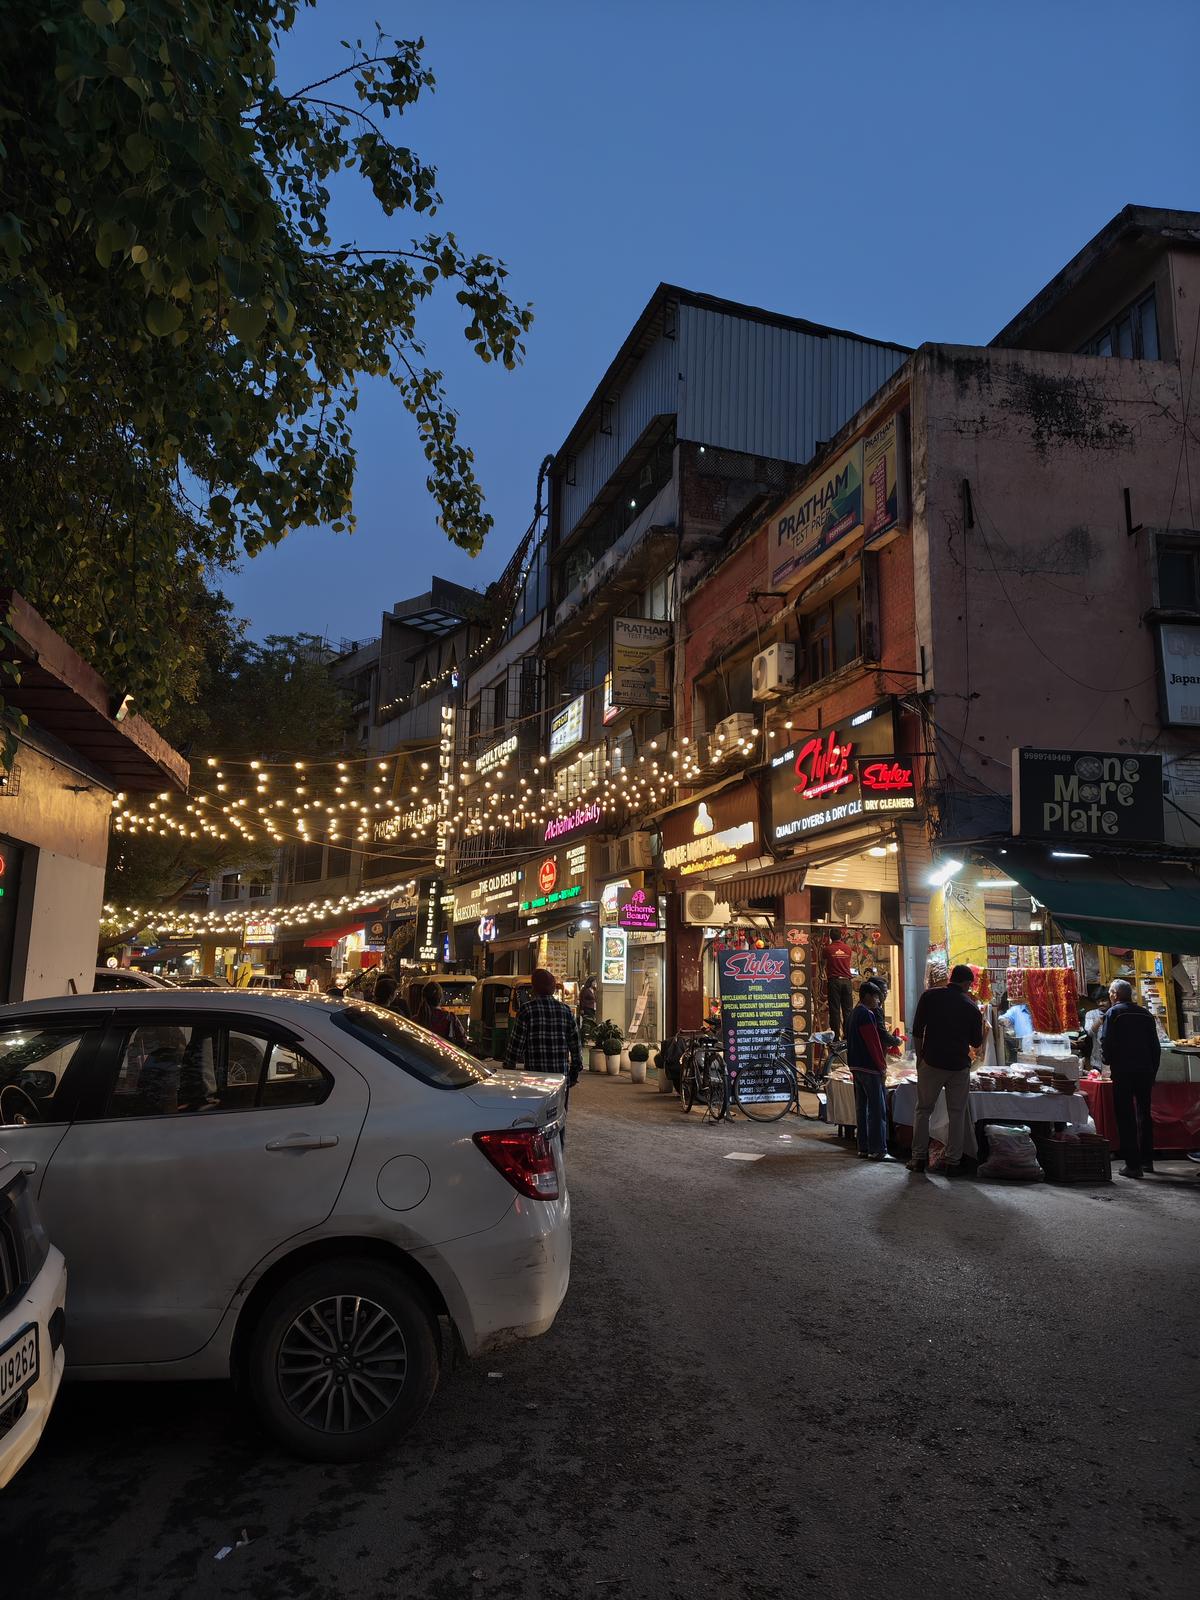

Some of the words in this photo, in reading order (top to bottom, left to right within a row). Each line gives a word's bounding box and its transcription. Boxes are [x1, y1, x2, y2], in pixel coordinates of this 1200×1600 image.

[865, 419, 895, 451] PRATHAM
[778, 465, 848, 546] PRATHAM
[792, 523, 809, 548] TEST
[616, 621, 668, 636] PRATHAM
[793, 730, 853, 797] Stylex
[862, 763, 912, 787] Stylex
[865, 799, 879, 810] DRY
[879, 798, 914, 810] CLEANERS
[1054, 774, 1134, 806] More
[544, 815, 575, 841] Alchemic
[575, 802, 600, 824] Beauty
[775, 820, 801, 838] QUALITY
[802, 812, 825, 830] DYERS
[825, 811, 831, 822] &
[832, 805, 847, 820] DRY
[1043, 802, 1119, 835] Plate
[479, 880, 488, 894] THE
[488, 876, 500, 891] OLD
[500, 870, 517, 888] DELHI
[621, 903, 656, 914] Alchemic
[626, 912, 650, 921] Beauty
[419, 946, 438, 954] CAFE
[724, 952, 784, 980] Stylex
[1, 1340, 35, 1396] U9262
